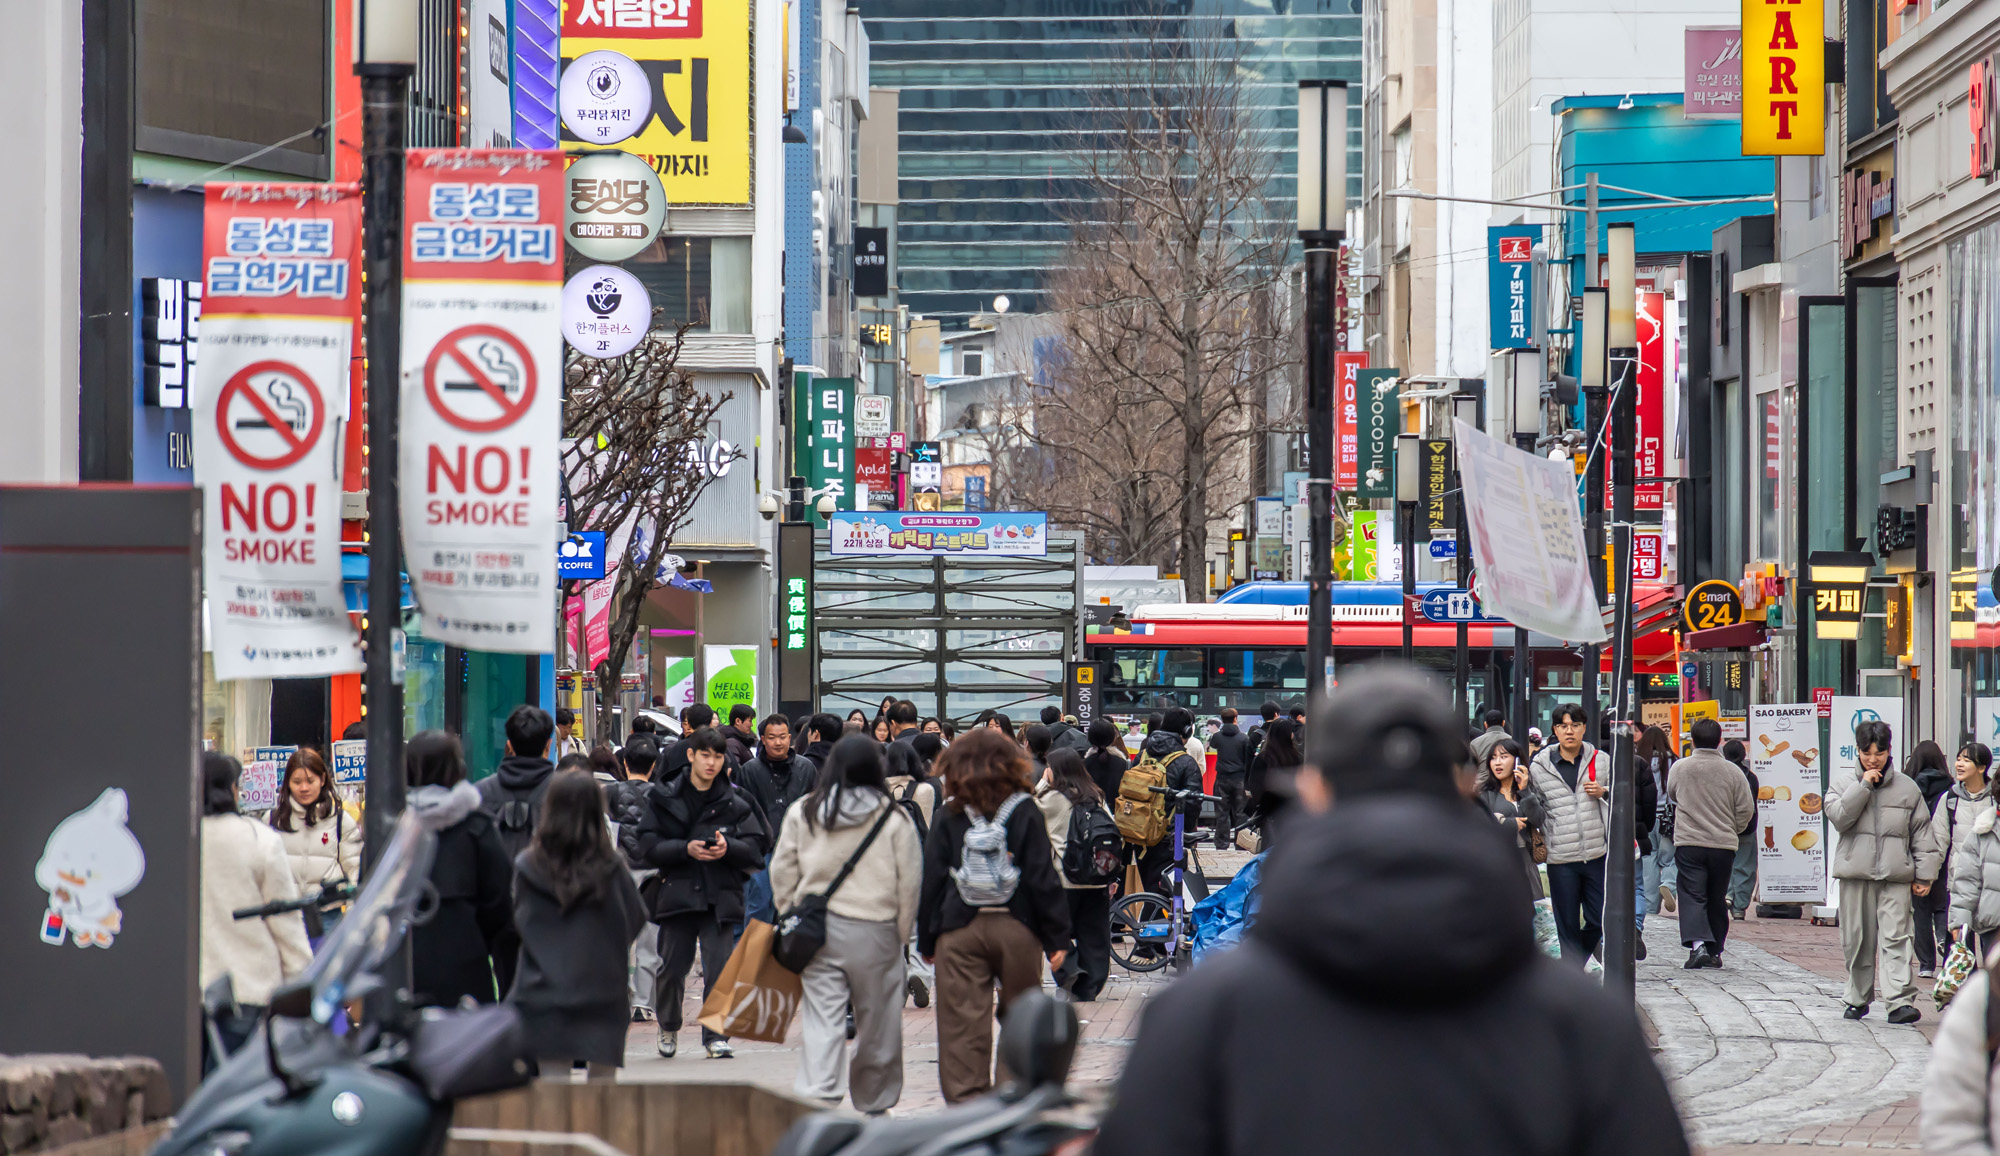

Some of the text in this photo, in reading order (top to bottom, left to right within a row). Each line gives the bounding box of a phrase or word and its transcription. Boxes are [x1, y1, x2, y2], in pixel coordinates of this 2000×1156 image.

[1765, 0, 1801, 140] ART
[597, 127, 610, 136] 5F
[434, 186, 535, 219] 동성로
[230, 221, 331, 254] 동성로
[416, 224, 553, 262] 금연거리
[577, 225, 642, 237] 베이커리 카페
[210, 261, 347, 297] 금연거리
[1510, 264, 1525, 339] 7번가피자
[576, 322, 632, 335] 한끼플러스
[597, 340, 610, 351] 2F
[1371, 377, 1384, 474] CROCODIL
[821, 388, 846, 511] 티파니주
[427, 445, 530, 495] NO!
[220, 482, 316, 533] NO!
[427, 500, 530, 526] SMOKE
[225, 538, 316, 564] SMOKE
[557, 541, 593, 557] OK
[844, 539, 883, 548] 22개 상점
[890, 529, 988, 550] 캐릭터 스트리트
[1699, 592, 1731, 602] emart
[1816, 589, 1860, 612] 커피
[788, 579, 807, 649] 質優價廉
[1699, 603, 1733, 628] 24
[715, 683, 749, 691] HELLO
[1755, 708, 1812, 717] SAO BAKERY
[352, 757, 366, 766] 59
[1840, 745, 1859, 760] 헤
